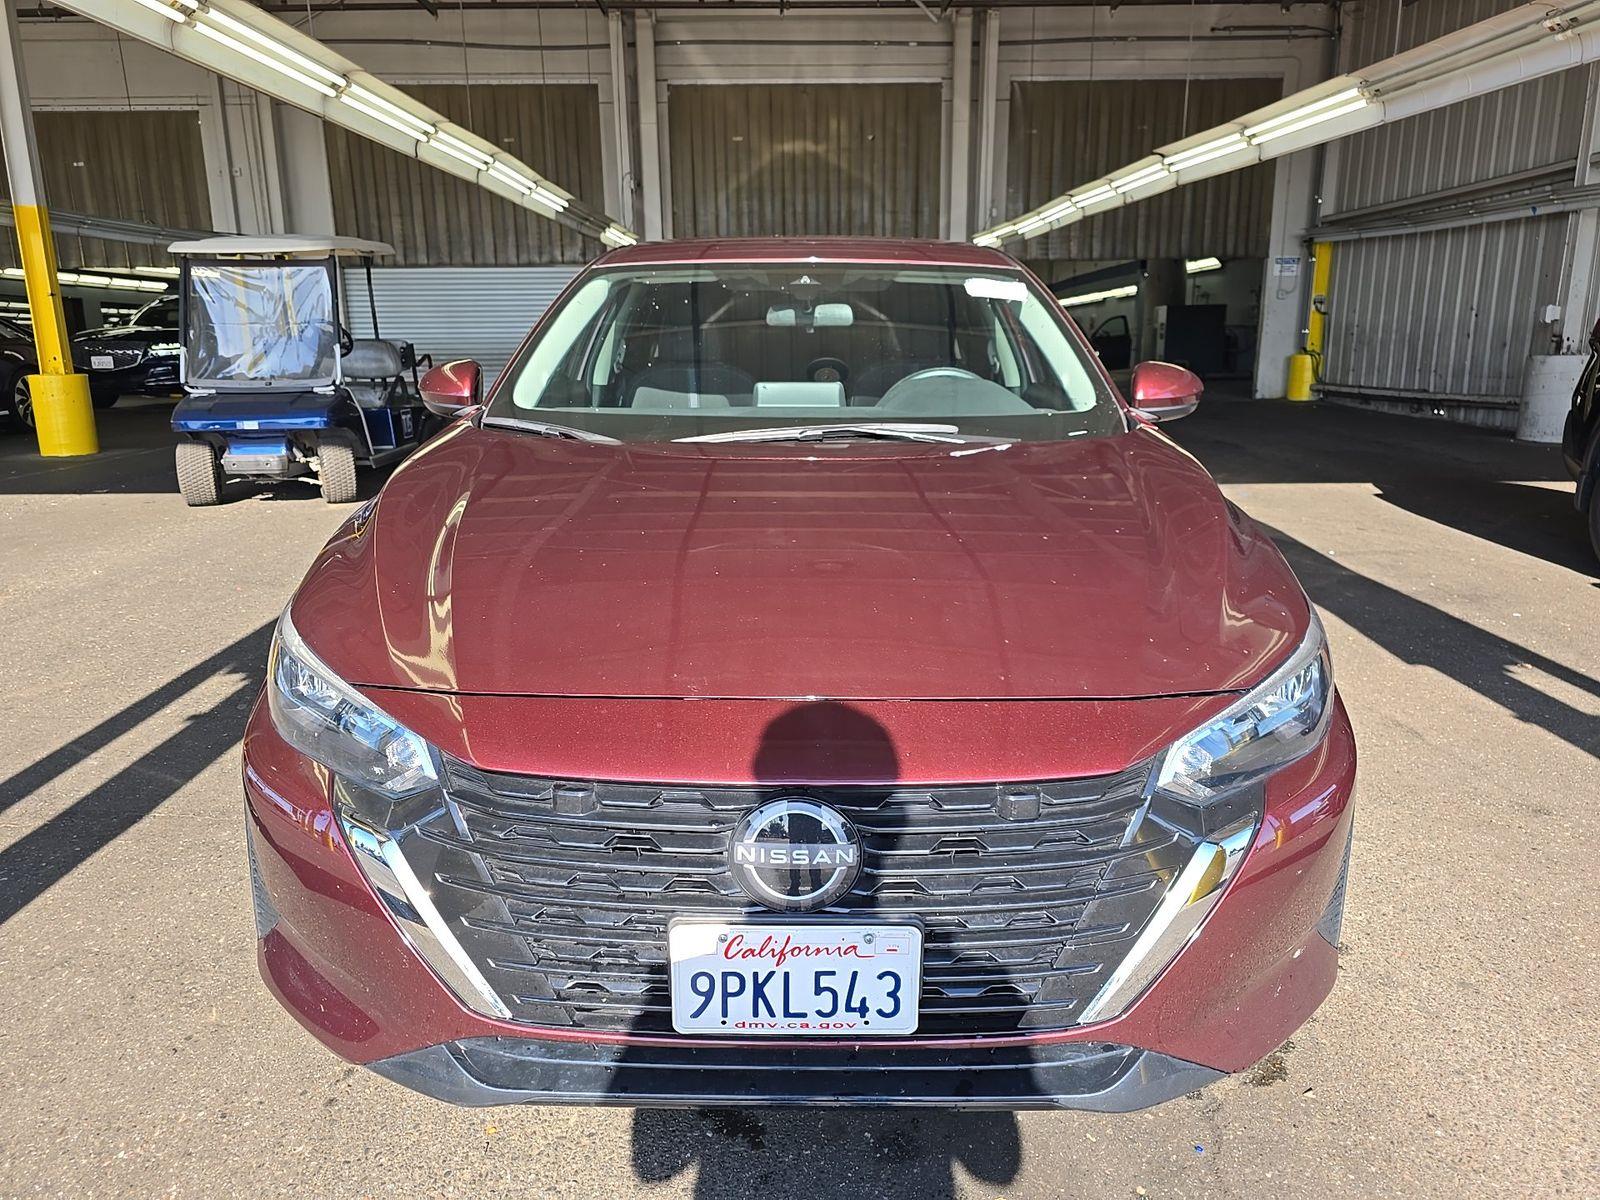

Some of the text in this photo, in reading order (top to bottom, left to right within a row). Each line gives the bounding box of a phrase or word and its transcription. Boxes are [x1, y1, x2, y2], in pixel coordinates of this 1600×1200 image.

[735, 845, 854, 865] NISSAN
[723, 934, 875, 967] California
[689, 970, 901, 1018] 9PKL543
[734, 1020, 857, 1029] dmv.ca.gov
